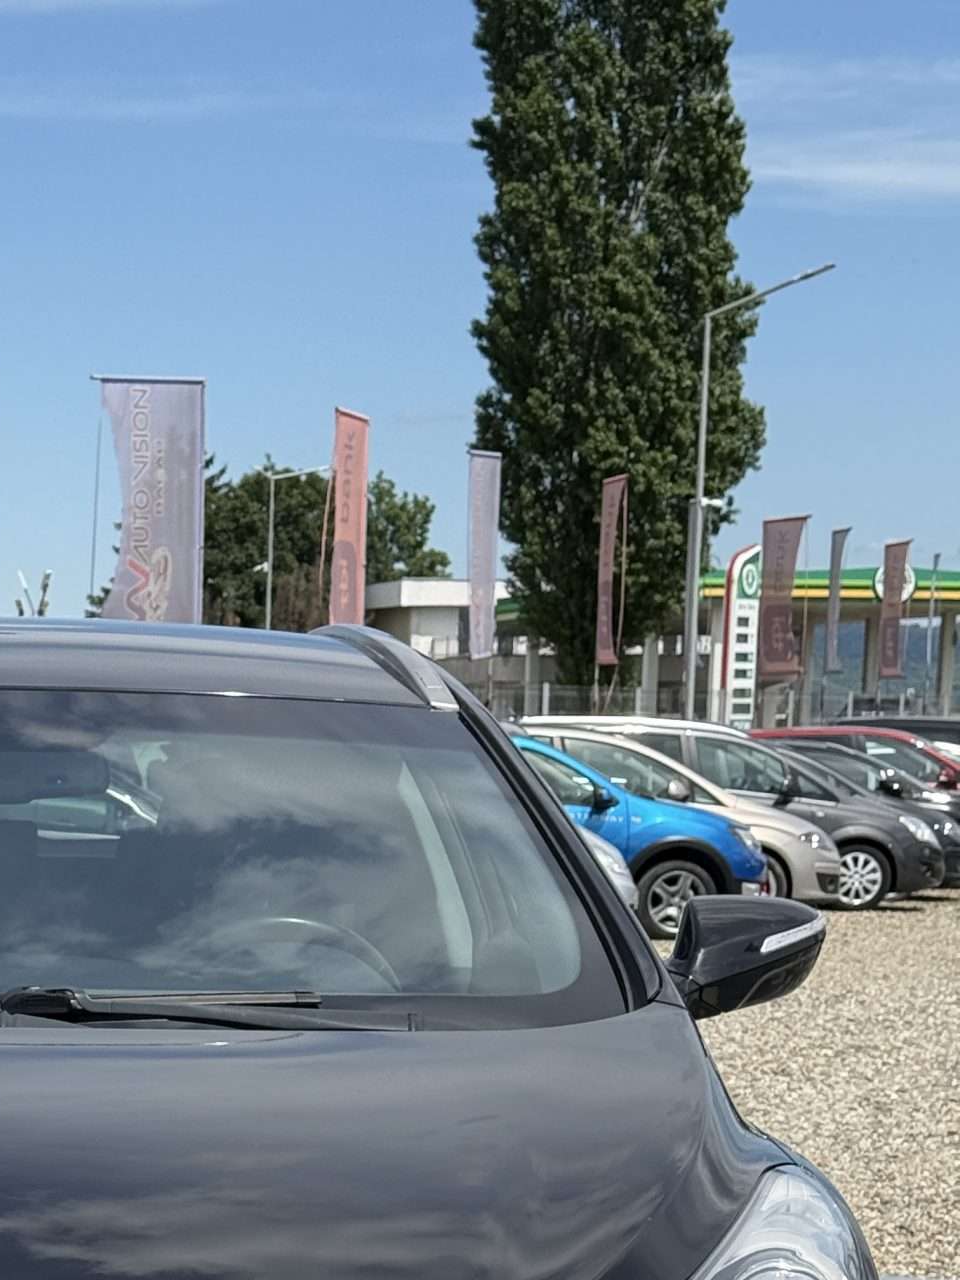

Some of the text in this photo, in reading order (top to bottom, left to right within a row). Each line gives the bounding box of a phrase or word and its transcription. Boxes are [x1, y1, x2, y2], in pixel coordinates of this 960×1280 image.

[130, 386, 151, 483] VISION
[339, 431, 355, 525] bank
[131, 488, 151, 565] AUTO
